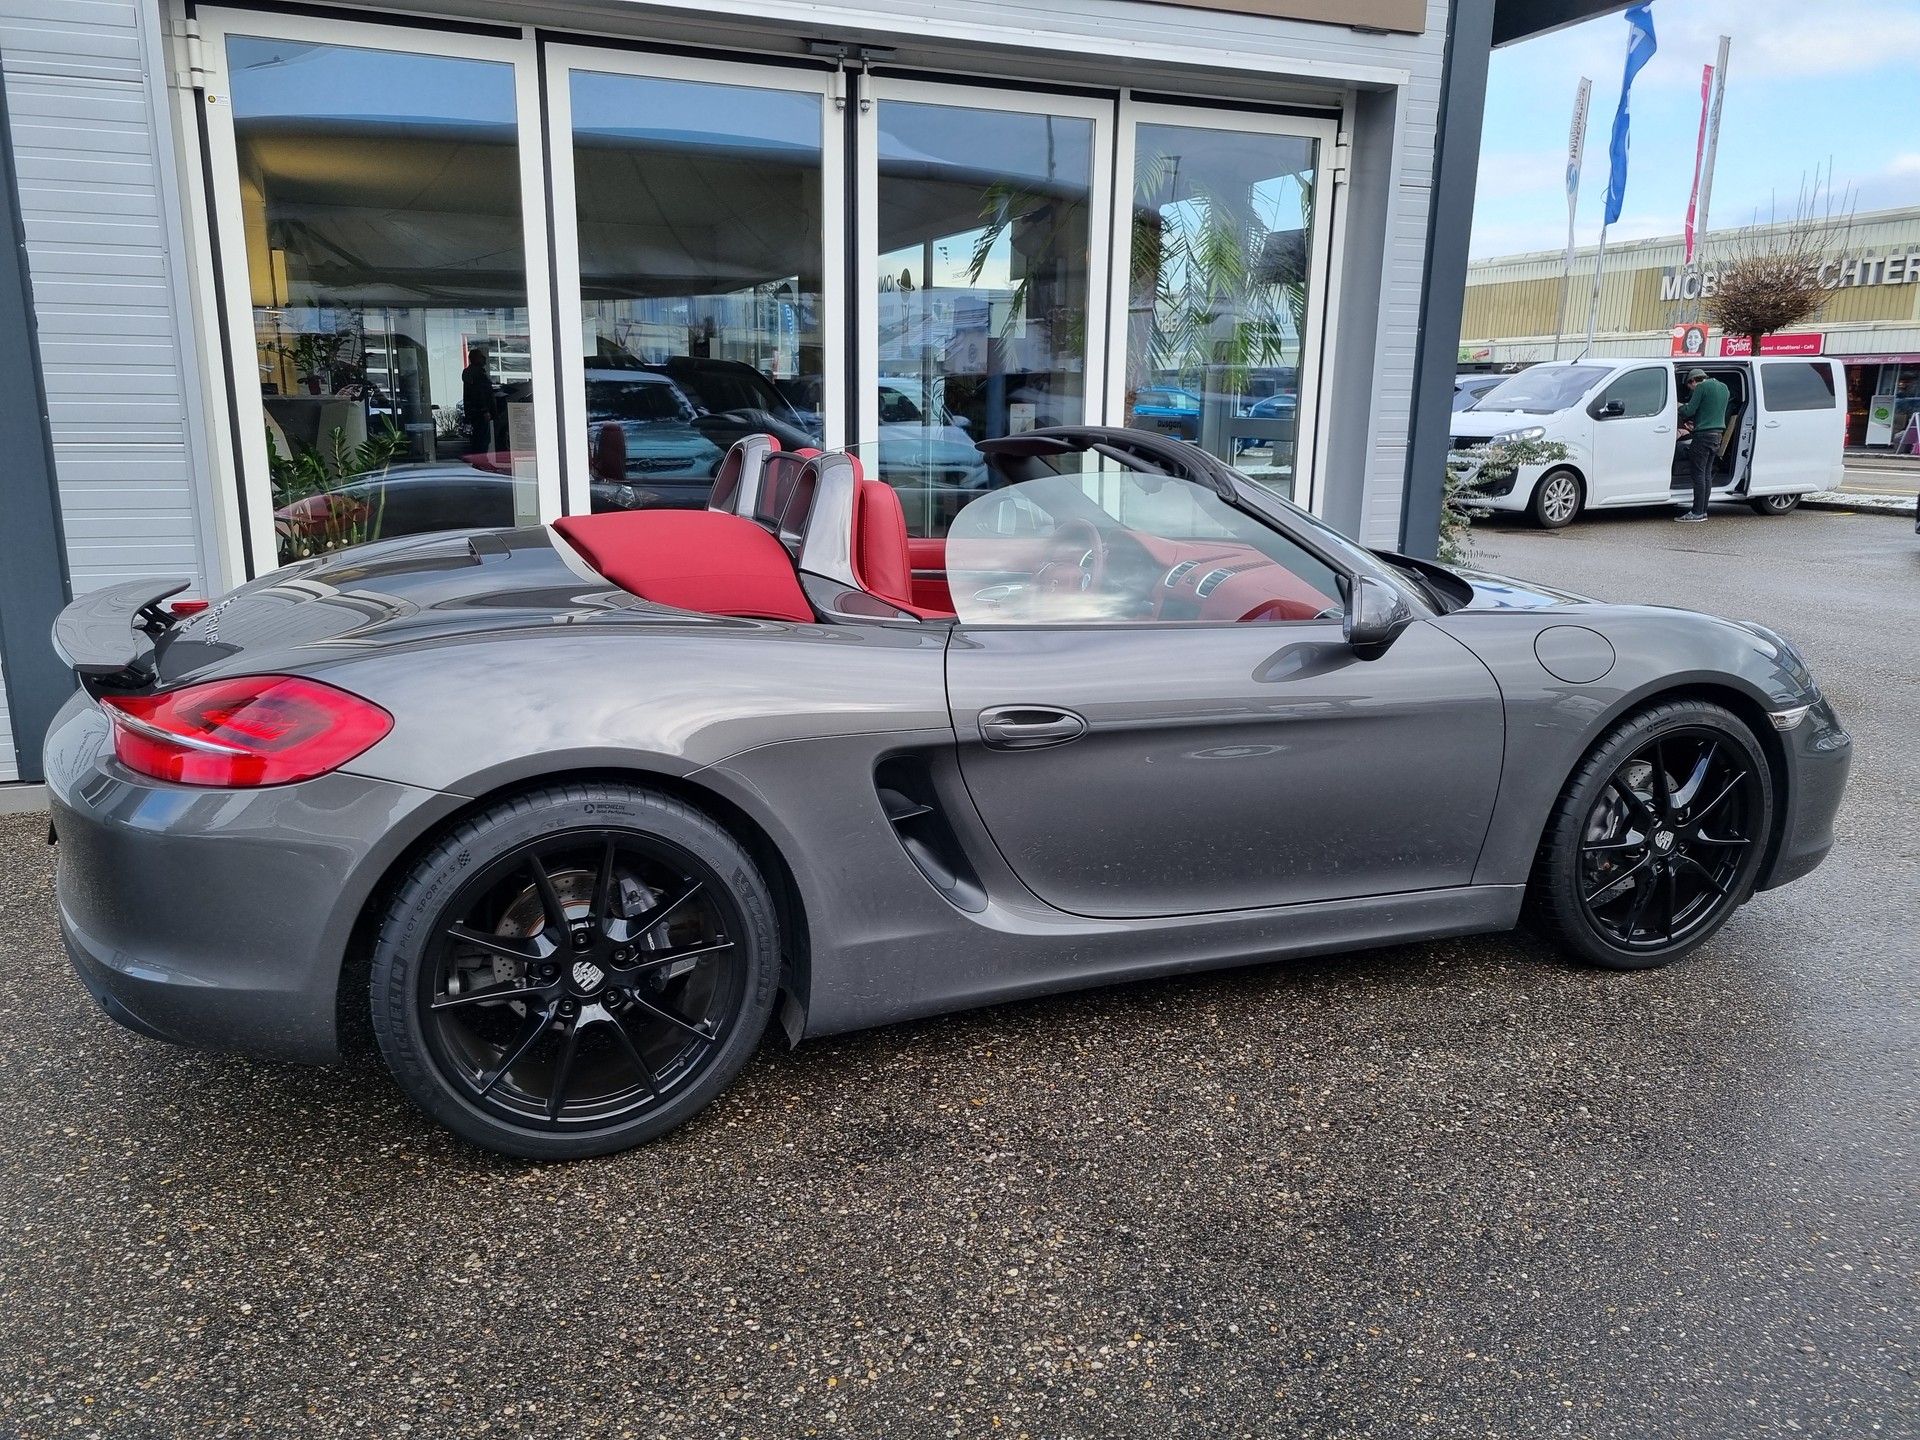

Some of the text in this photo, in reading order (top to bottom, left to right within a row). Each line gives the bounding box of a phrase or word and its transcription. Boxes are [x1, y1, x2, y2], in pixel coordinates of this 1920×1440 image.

[400, 914, 417, 949] PILOT
[416, 876, 443, 914] SPORT
[449, 864, 456, 873] S
[746, 895, 772, 1001] MICHELIN
